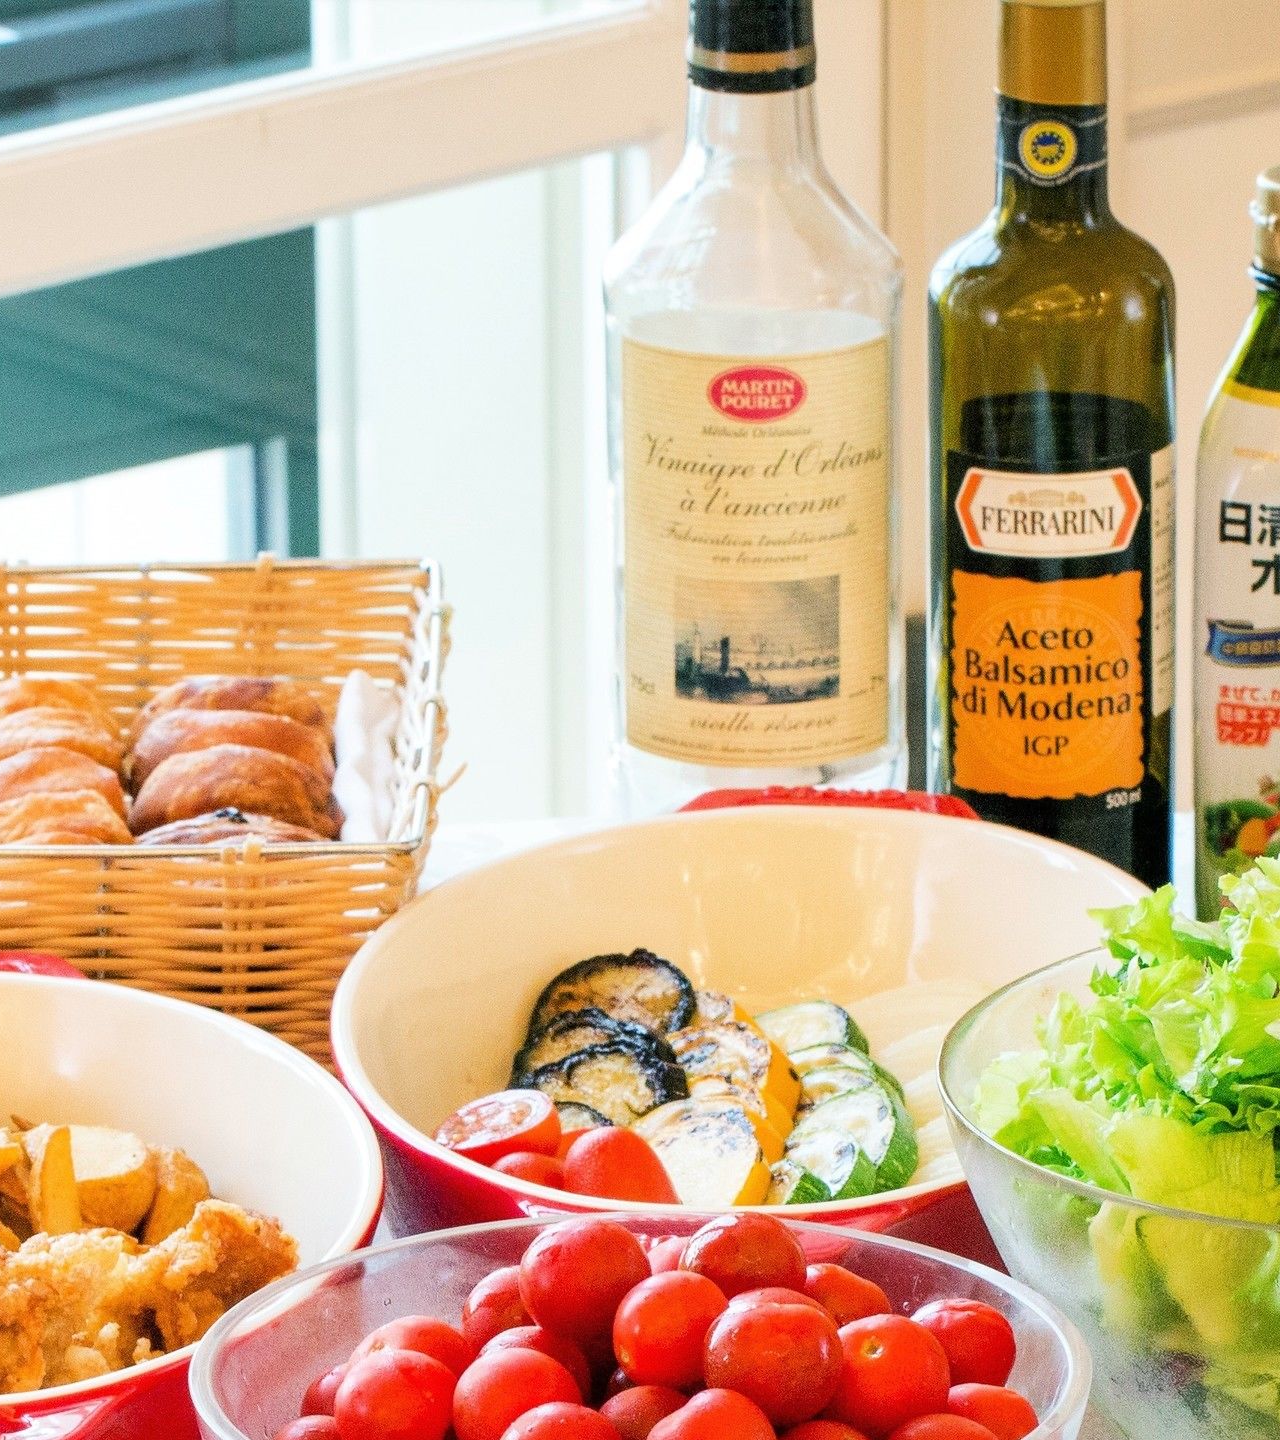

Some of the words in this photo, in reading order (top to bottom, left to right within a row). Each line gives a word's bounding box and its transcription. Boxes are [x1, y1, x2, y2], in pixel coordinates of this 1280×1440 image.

[720, 380, 794, 394] MARTIN
[720, 395, 794, 410] POURET
[644, 432, 755, 488] Vinaigre
[680, 489, 696, 512] à
[704, 487, 847, 518] l'ancienne
[981, 505, 1114, 537] FERRARINI
[996, 620, 1094, 651] Aceto
[965, 648, 1129, 687] Balsamico
[962, 685, 987, 717] di
[997, 690, 1132, 722] Modena
[1023, 735, 1070, 758] IGP
